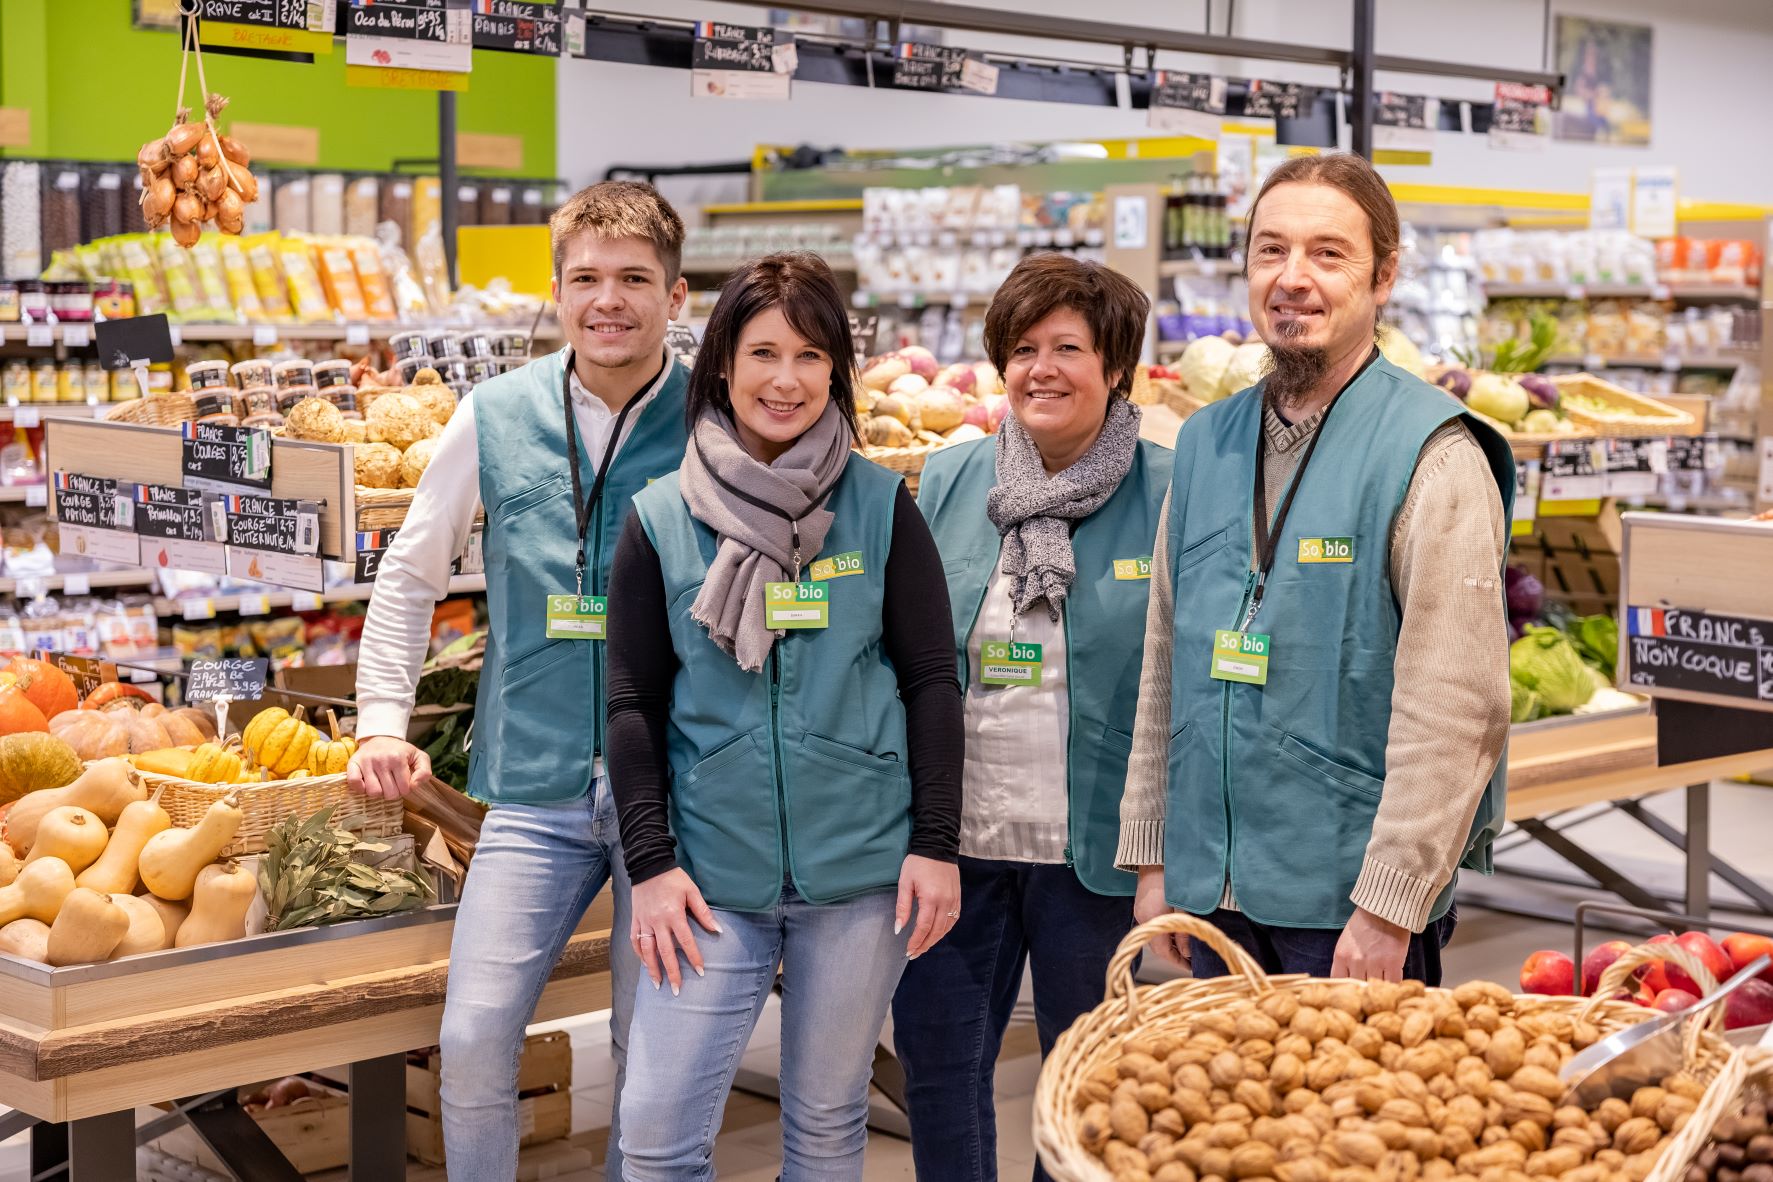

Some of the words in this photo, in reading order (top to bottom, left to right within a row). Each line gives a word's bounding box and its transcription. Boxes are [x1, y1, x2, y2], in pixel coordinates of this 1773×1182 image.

[205, 1, 243, 17] RAVE
[197, 425, 224, 442] FRANCE
[69, 474, 101, 495] FRANCE
[240, 496, 276, 517] FRANCE
[233, 529, 279, 548] BUTTERNUT
[191, 660, 256, 671] COURGE
[988, 666, 1028, 674] VERONIQUE
[1681, 649, 1754, 682] COQUE
